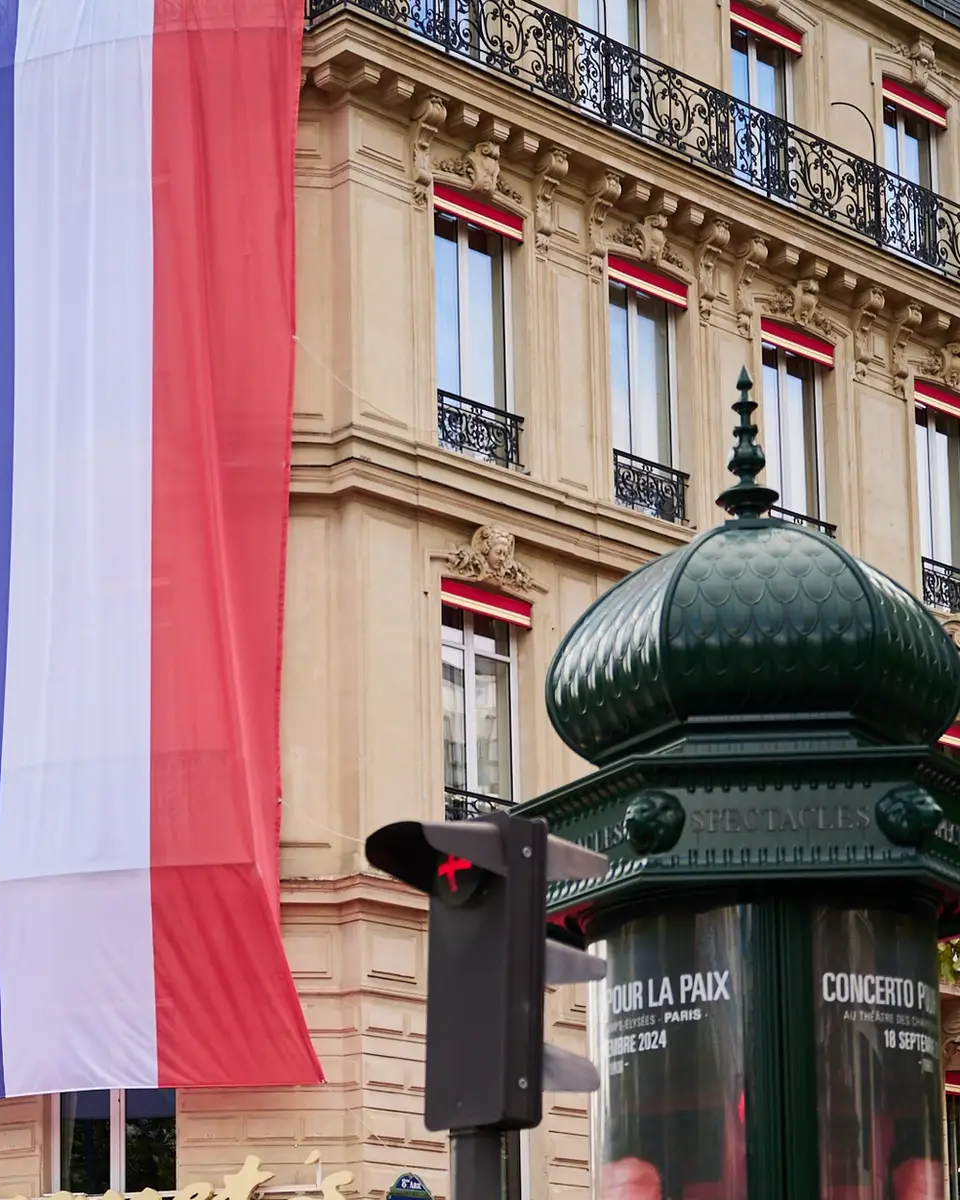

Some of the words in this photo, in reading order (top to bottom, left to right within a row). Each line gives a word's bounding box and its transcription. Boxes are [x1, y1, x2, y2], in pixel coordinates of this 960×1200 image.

[691, 806, 871, 834] SPECTACLES
[648, 976, 674, 1008] LA
[680, 970, 730, 1004] PAIX
[822, 972, 914, 1009] CONCERTO
[664, 1008, 702, 1023] PARIS
[843, 1009, 857, 1022] AU
[638, 1029, 667, 1051] 2024
[884, 1029, 896, 1049] 18
